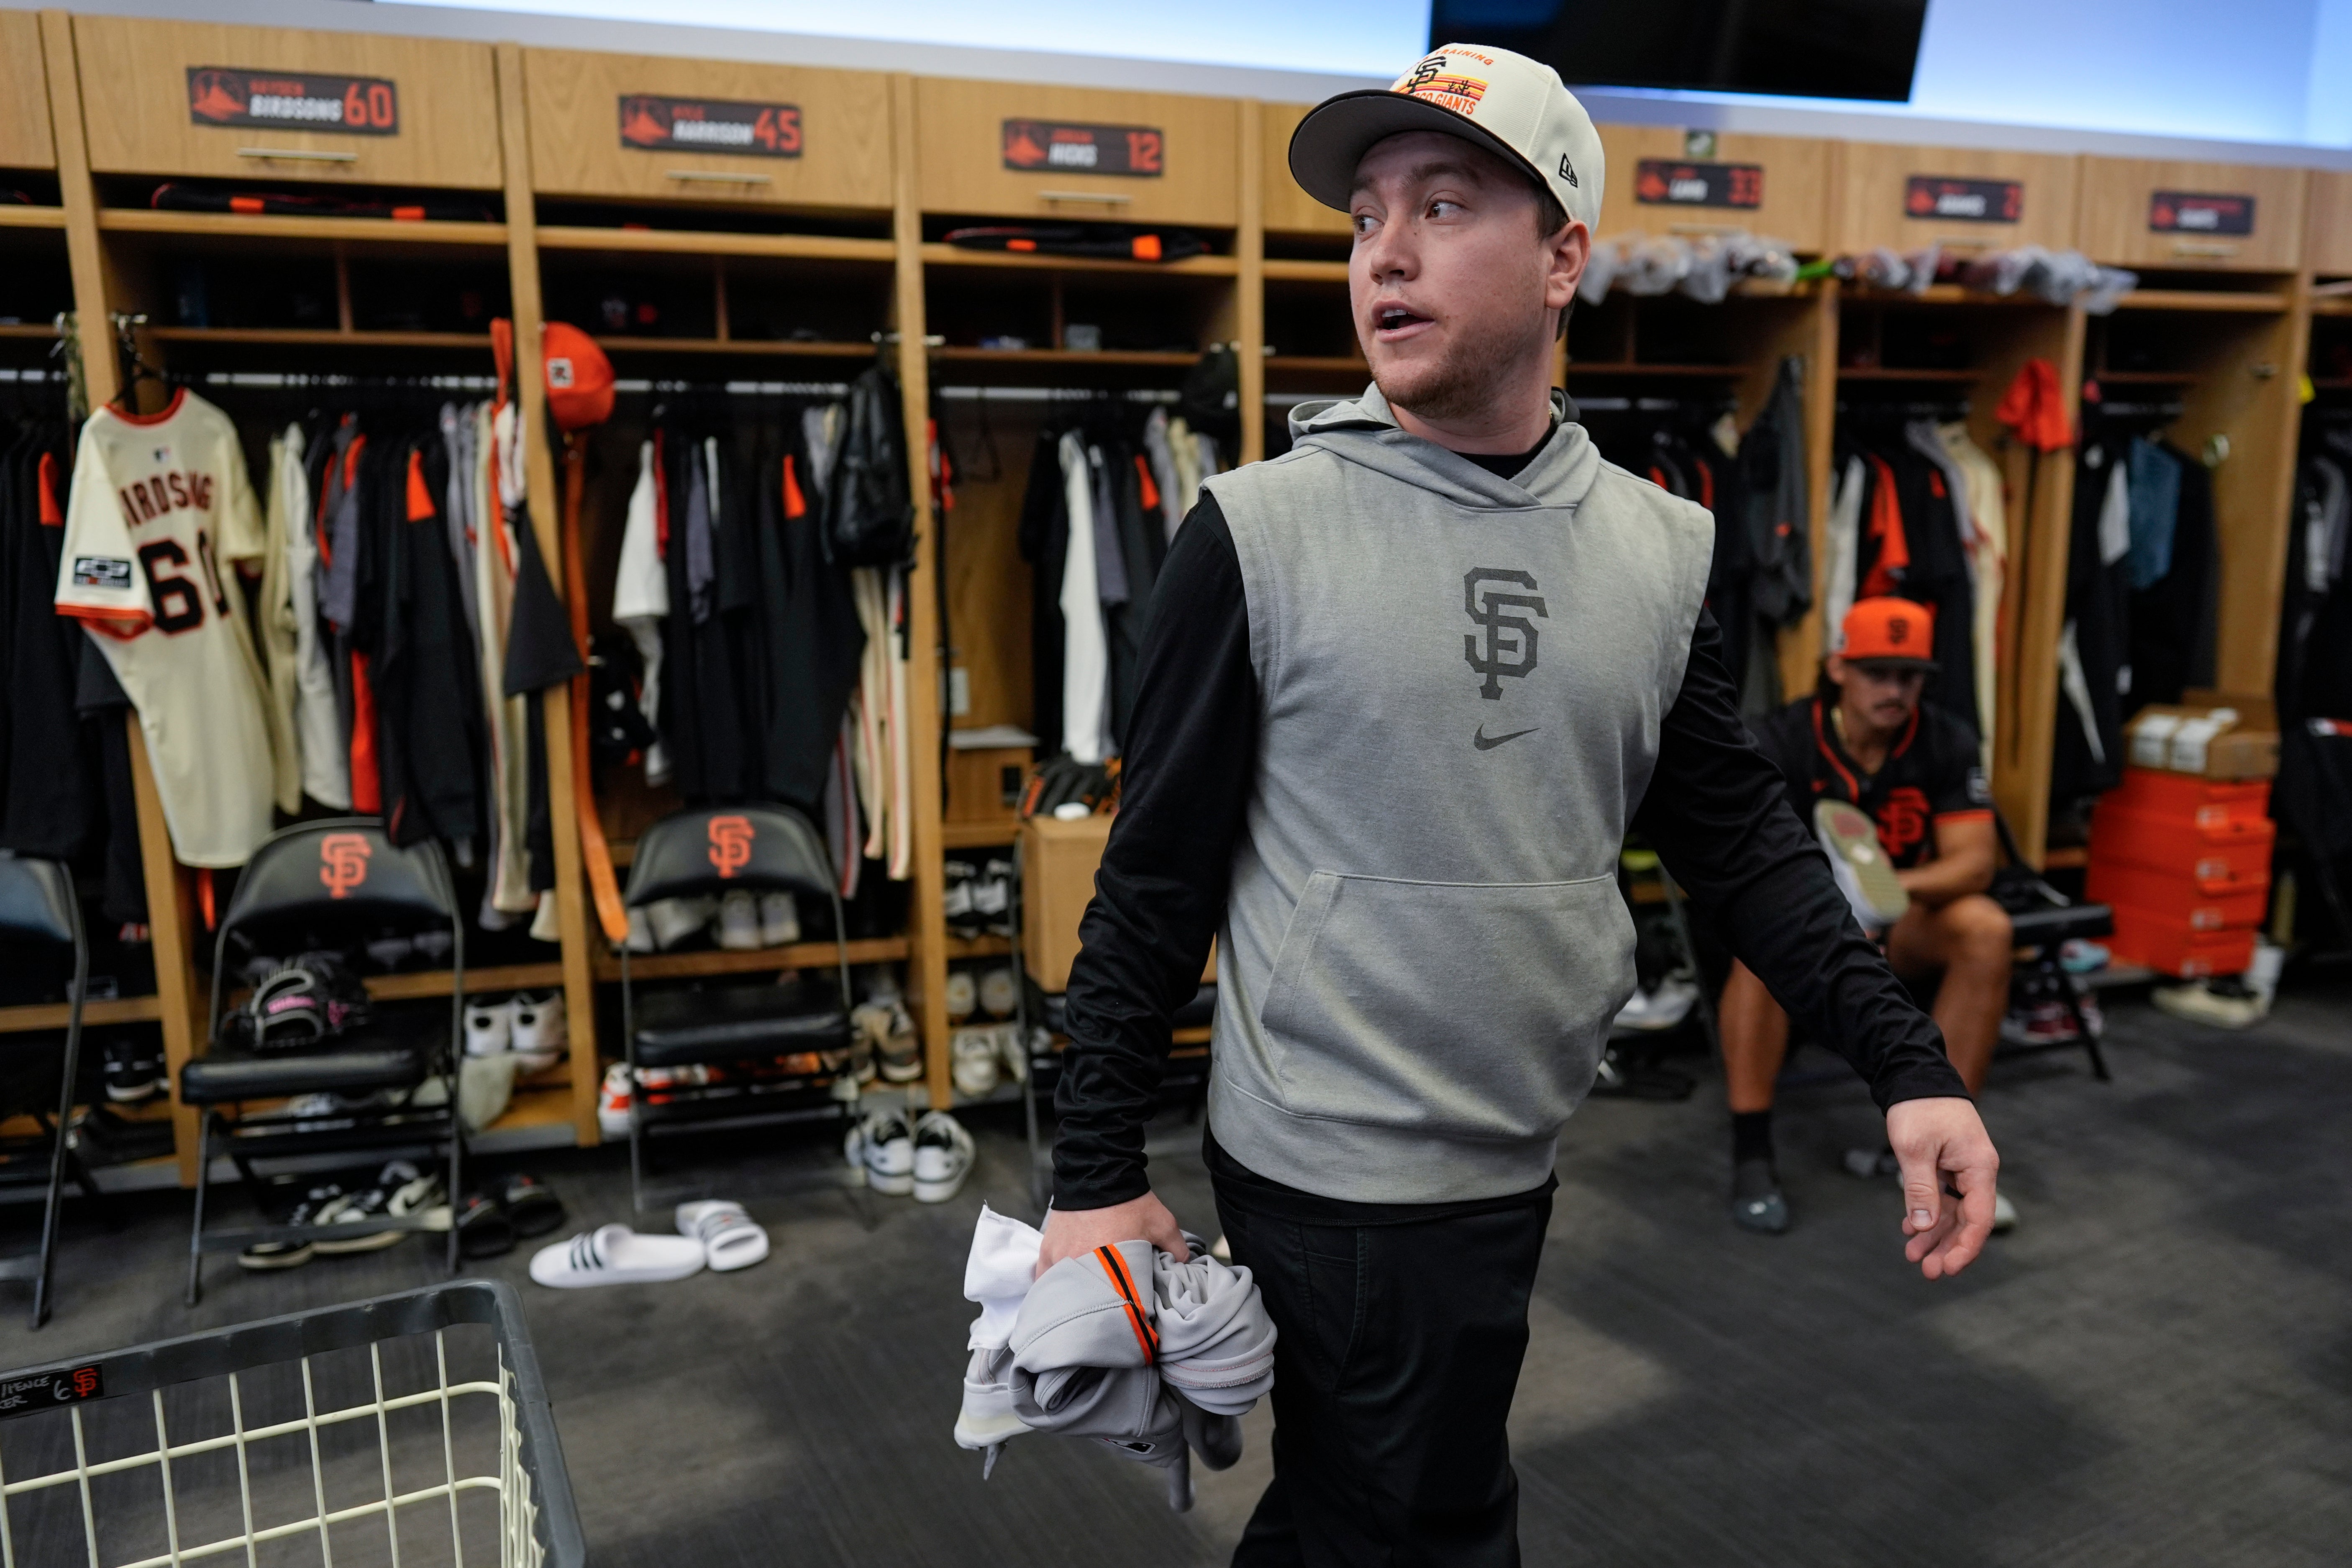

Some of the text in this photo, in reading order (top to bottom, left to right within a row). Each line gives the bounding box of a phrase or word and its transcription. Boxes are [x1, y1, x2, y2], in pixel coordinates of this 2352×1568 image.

[1407, 56, 1447, 94] SF
[1435, 49, 1494, 65] TRAINING
[343, 83, 394, 126] 60
[1434, 93, 1476, 115] GIANTS
[754, 108, 801, 151] 45
[1126, 131, 1161, 171] 12
[1463, 566, 1550, 700] SF
[1876, 784, 1931, 857] SF
[320, 833, 373, 899] SF
[708, 816, 756, 879] SF
[73, 1368, 98, 1397] SF
